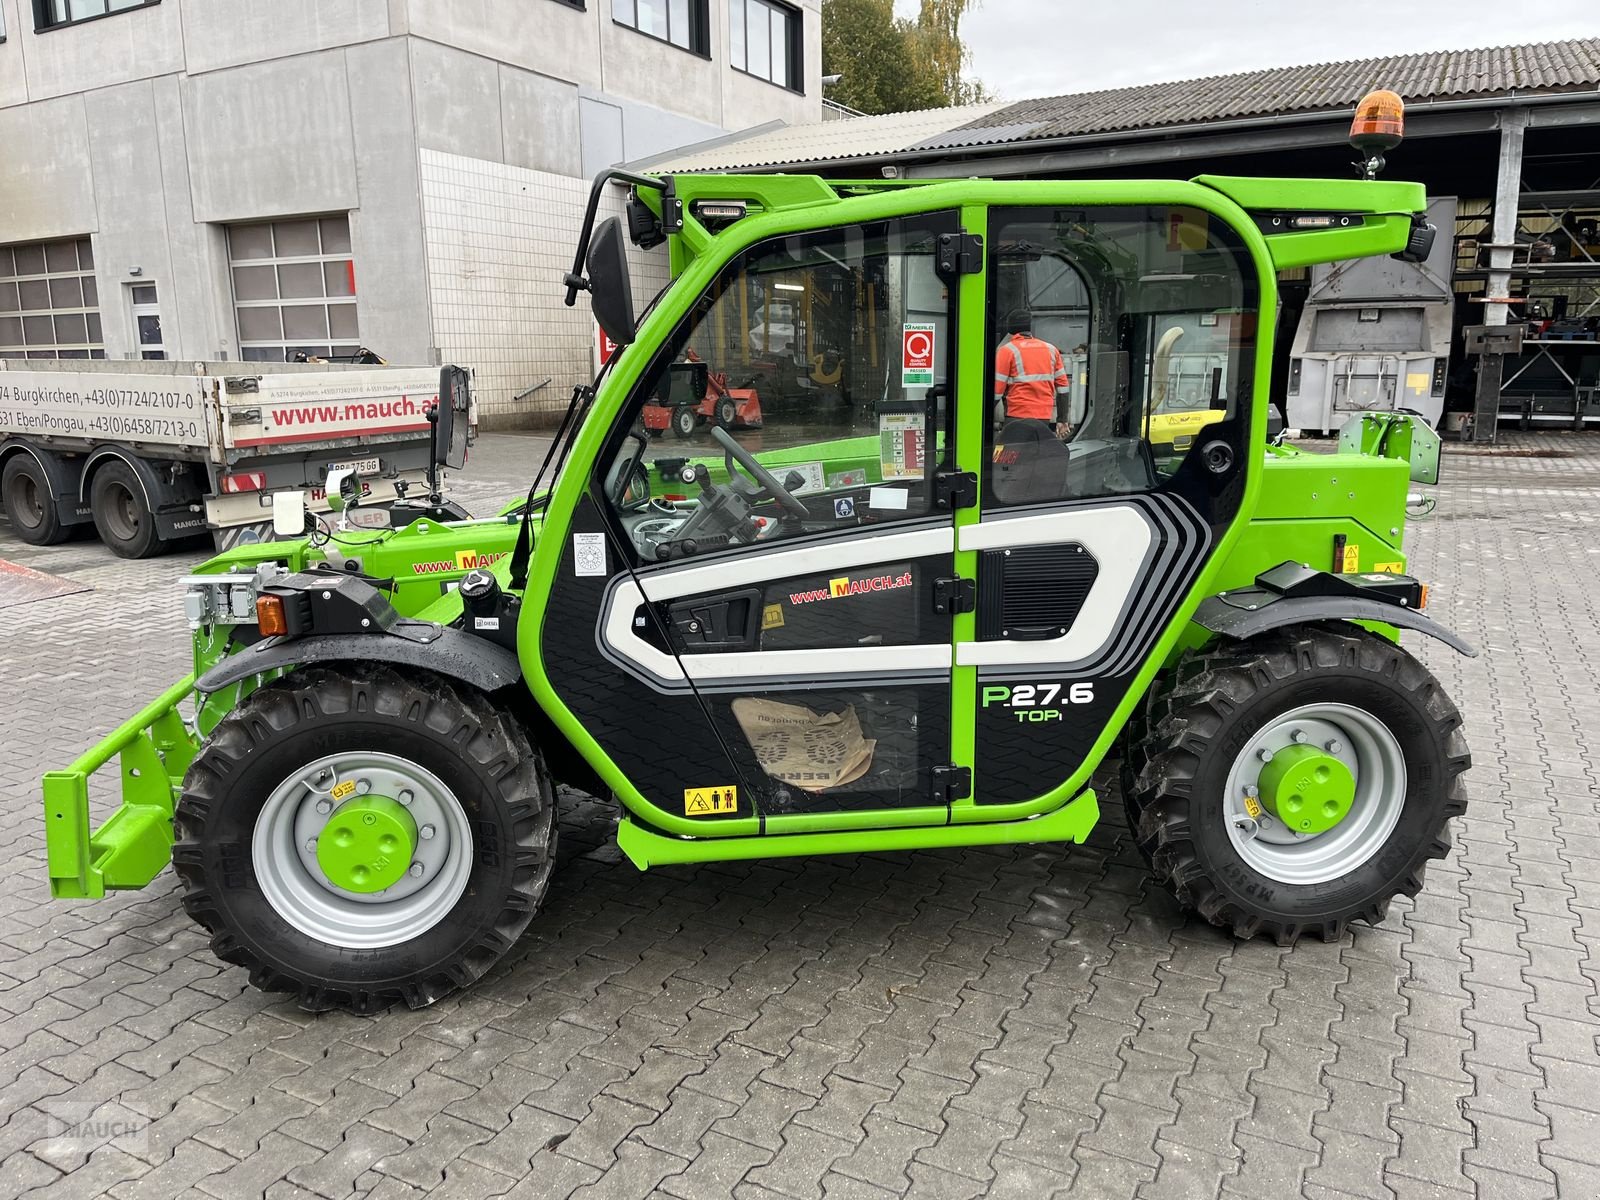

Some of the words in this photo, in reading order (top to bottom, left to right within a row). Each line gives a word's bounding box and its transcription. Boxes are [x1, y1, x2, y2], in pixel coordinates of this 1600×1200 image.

[906, 333, 931, 358] Q
[14, 386, 83, 406] Burgkirchen,
[85, 389, 194, 410] +43(0)7724/2107-0
[17, 412, 87, 433] Eben/Pongau,
[89, 416, 197, 438] +43(0)6458/7213-0
